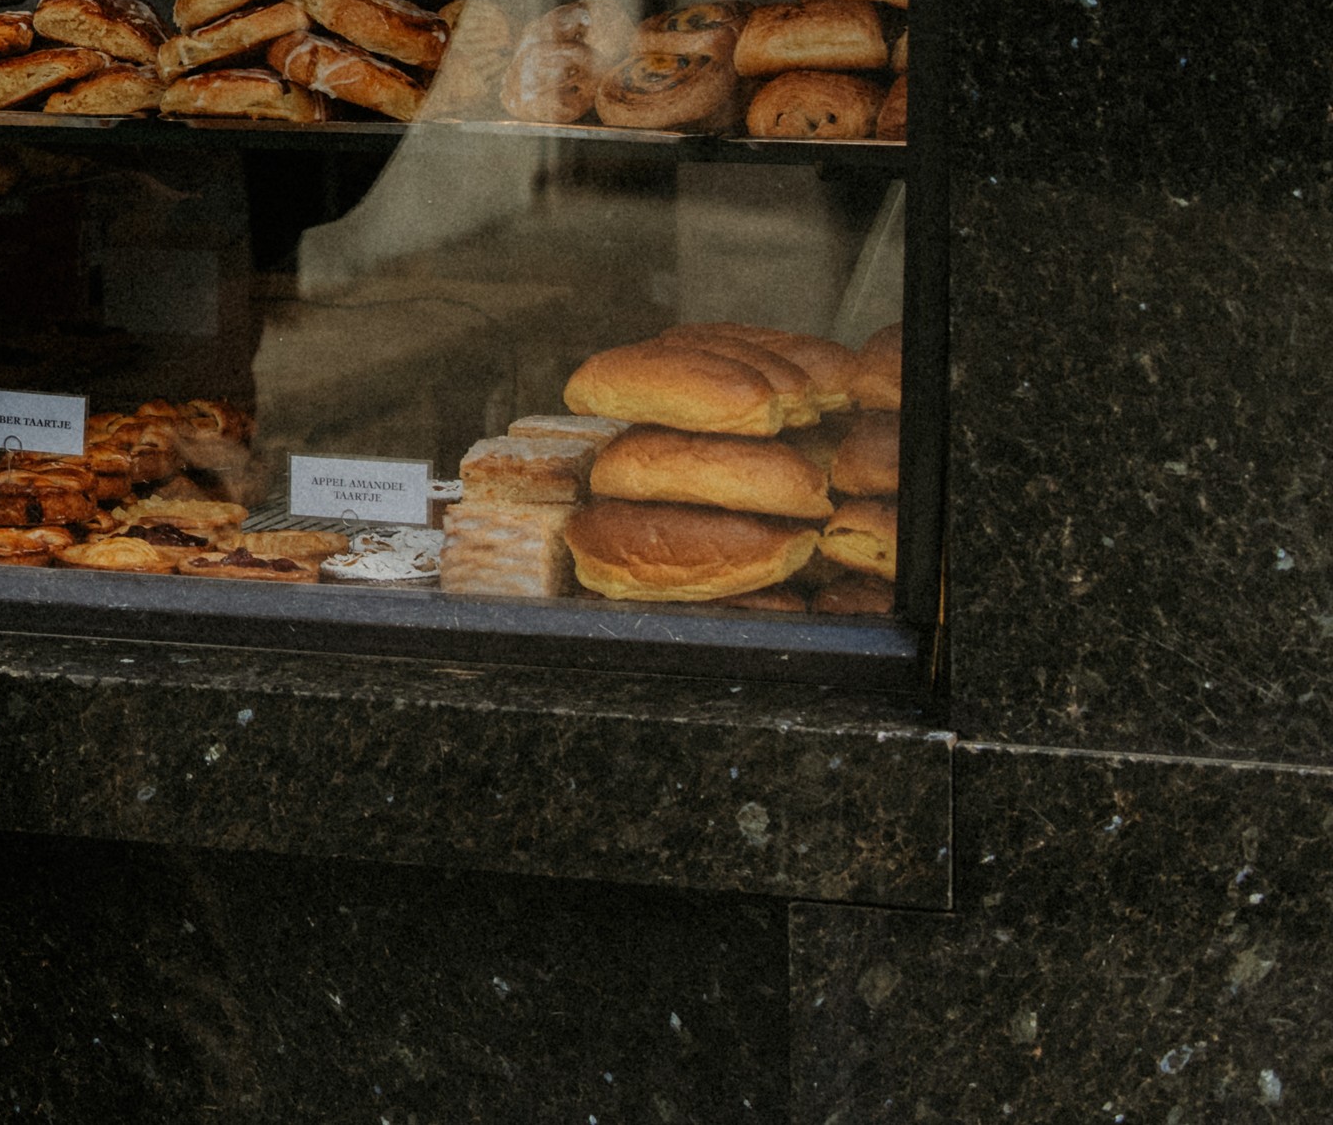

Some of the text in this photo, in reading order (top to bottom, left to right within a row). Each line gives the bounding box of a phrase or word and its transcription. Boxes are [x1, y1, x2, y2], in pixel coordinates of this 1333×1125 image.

[23, 417, 72, 430] TAARTJE
[311, 476, 406, 492] APPEL AMANDEL
[334, 491, 382, 503] TAARTJE
